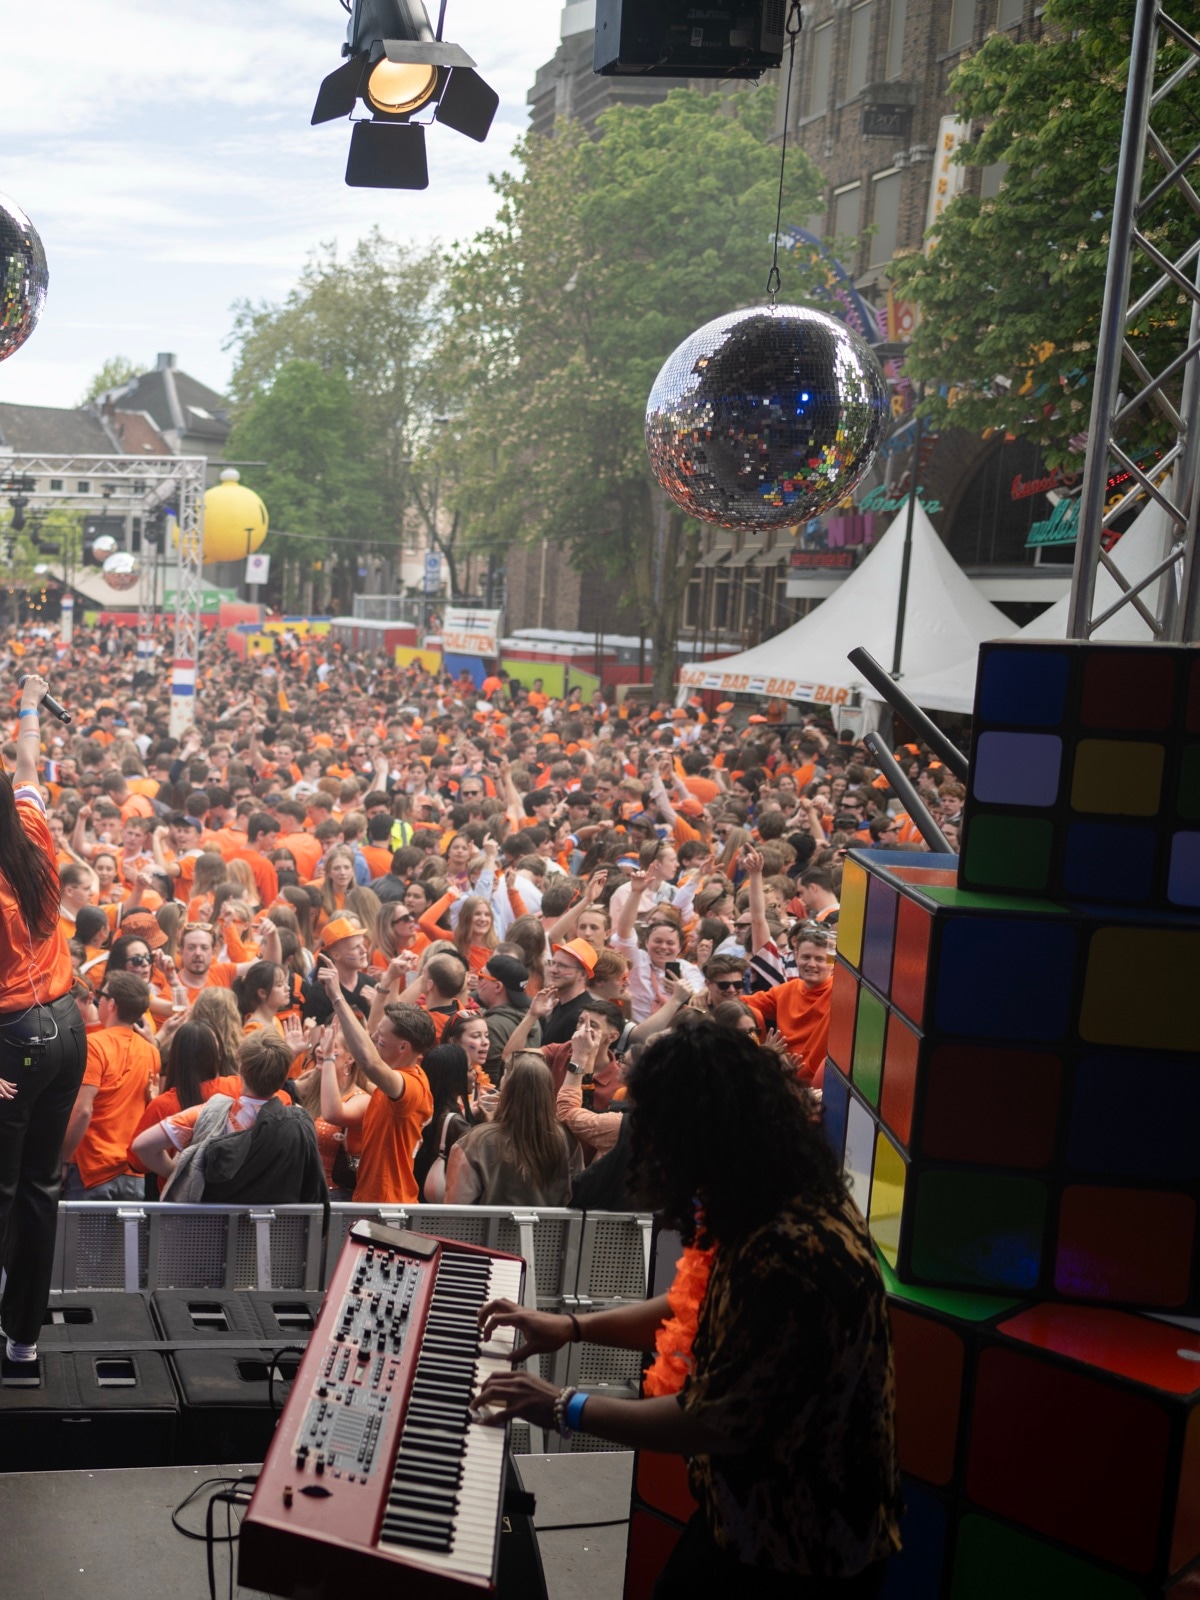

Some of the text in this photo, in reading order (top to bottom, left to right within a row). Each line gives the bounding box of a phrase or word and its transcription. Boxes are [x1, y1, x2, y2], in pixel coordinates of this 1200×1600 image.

[828, 514, 874, 547] NU!
[680, 671, 849, 704] BAR BAR BAR BAR
